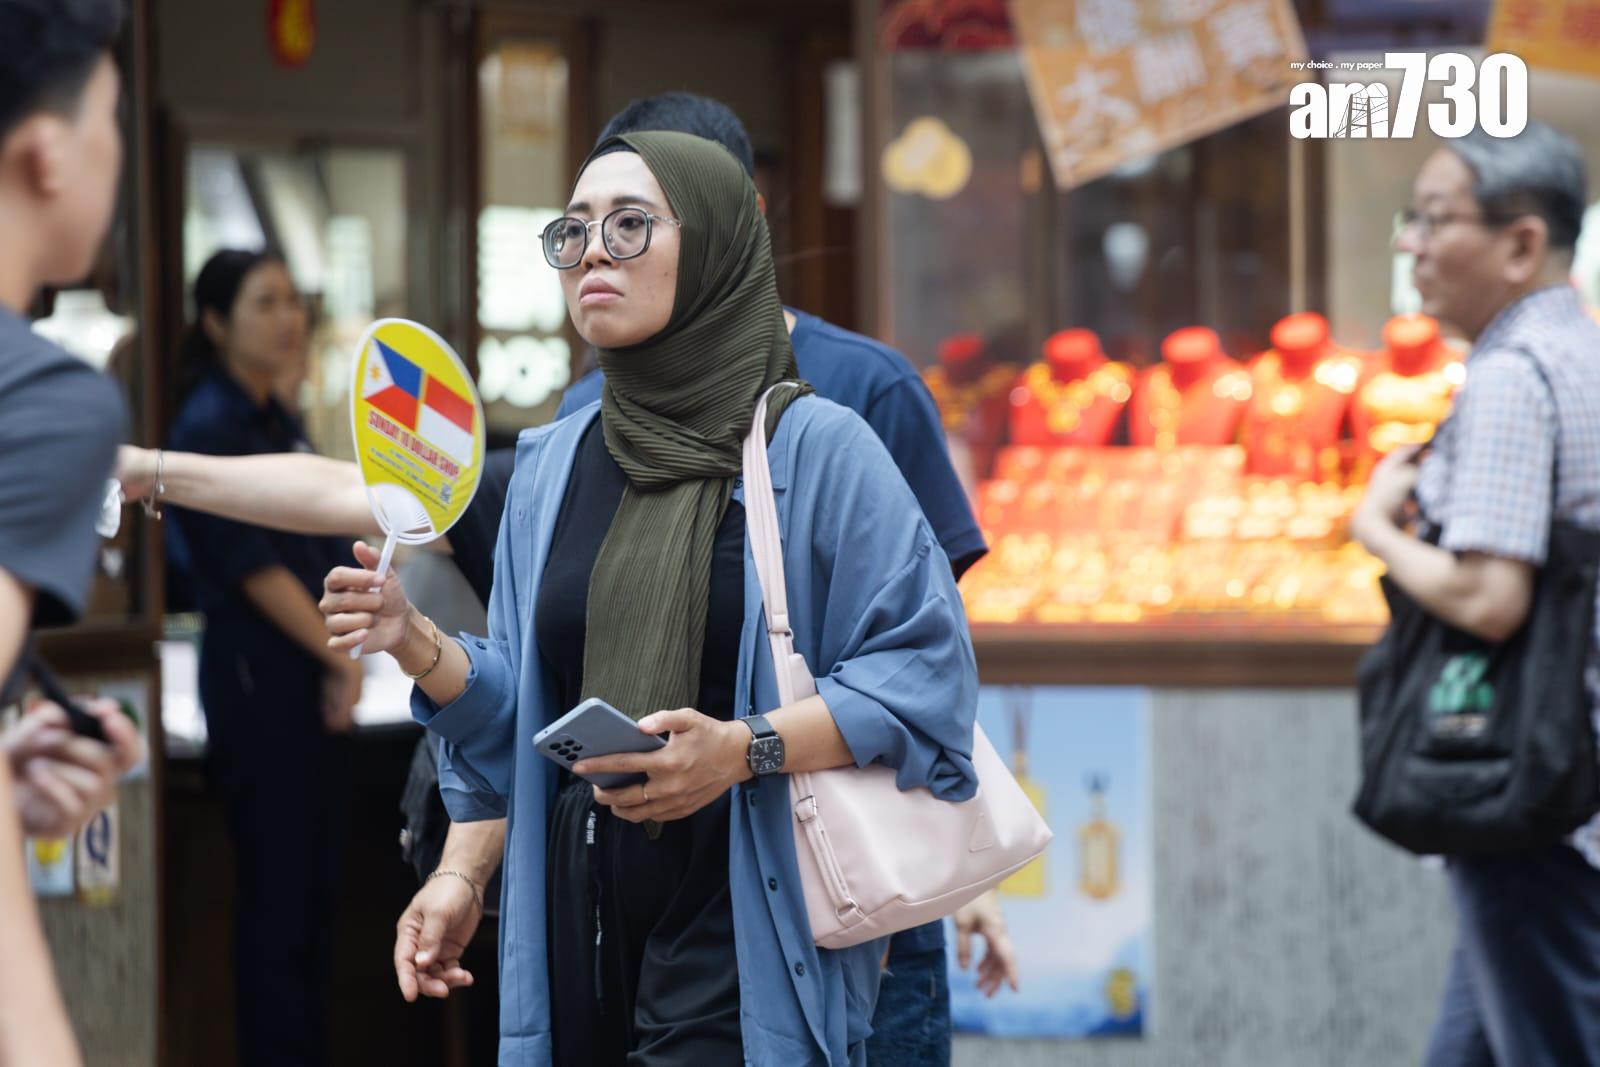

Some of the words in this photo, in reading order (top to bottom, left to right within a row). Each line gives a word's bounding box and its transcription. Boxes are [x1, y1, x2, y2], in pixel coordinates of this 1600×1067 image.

[369, 411, 400, 439] SUNDAY
[411, 436, 438, 466] DOLLAR
[439, 455, 459, 477] SHOP
